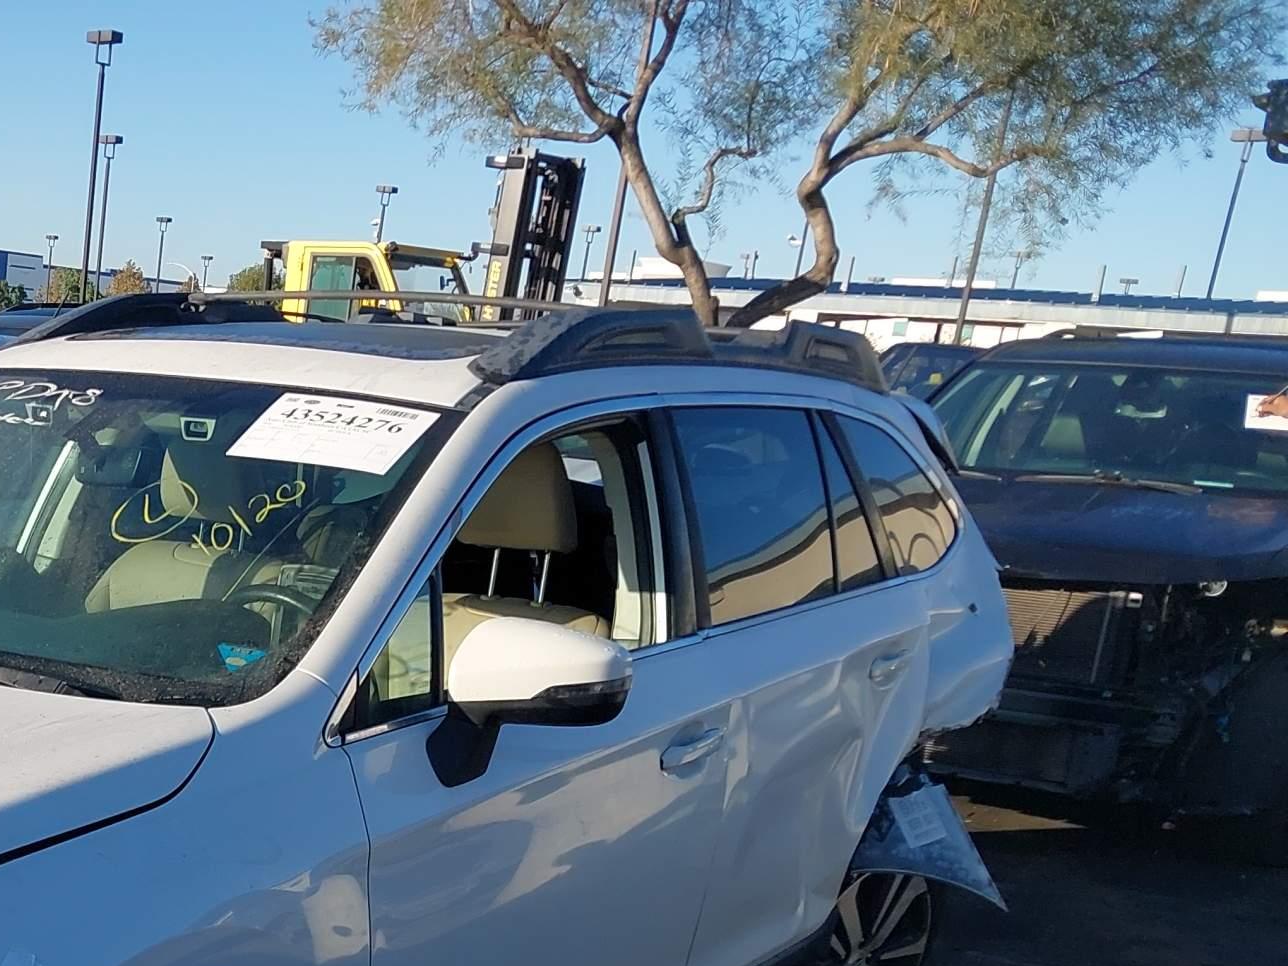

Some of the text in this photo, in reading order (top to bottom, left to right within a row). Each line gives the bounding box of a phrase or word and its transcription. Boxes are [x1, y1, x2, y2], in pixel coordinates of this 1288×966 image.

[483, 259, 503, 321] HSTER
[280, 407, 409, 434] 43524276
[191, 479, 307, 557] 10/20
